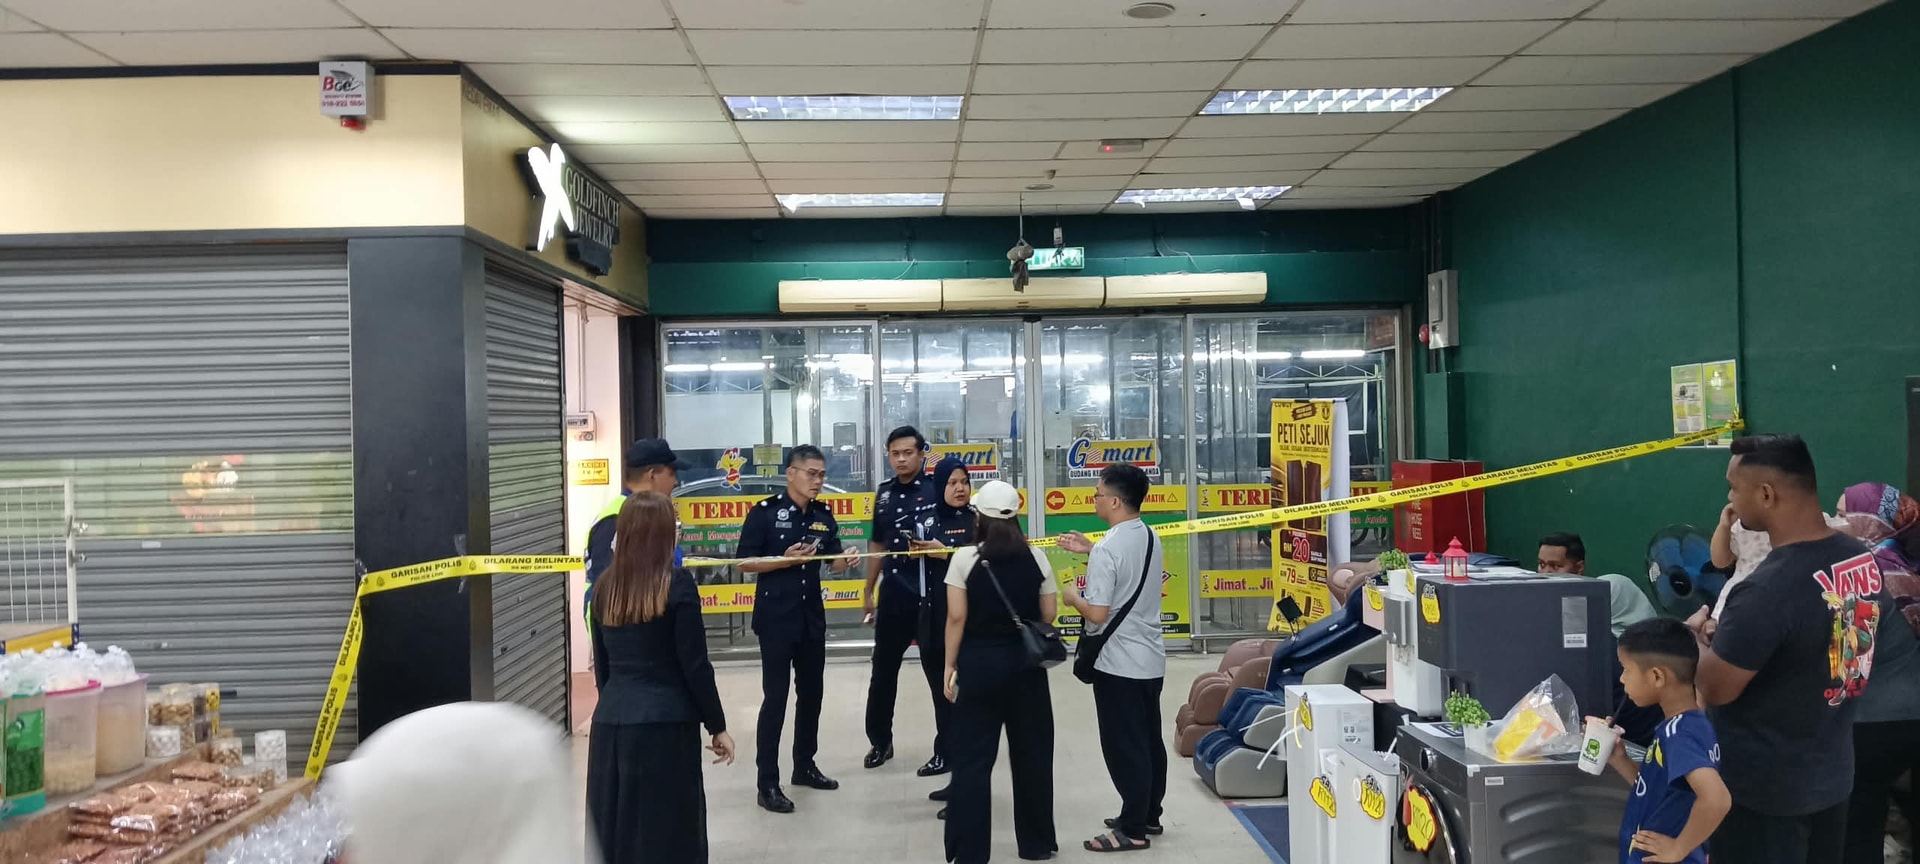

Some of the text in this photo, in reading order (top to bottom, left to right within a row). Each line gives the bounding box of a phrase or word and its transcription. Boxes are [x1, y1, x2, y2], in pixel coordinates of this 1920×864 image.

[565, 167, 620, 227] GOLDFINCH
[574, 205, 614, 249] JEWELRY
[1278, 423, 1330, 446] PETI SEJUK
[1069, 439, 1153, 468] G mart
[1576, 445, 1639, 461] GARISAN POLIS
[1472, 461, 1558, 482] DILARANG MELINTAS
[1390, 481, 1454, 497] GARISAN POLIS
[1283, 496, 1371, 514] DILARANG MELINTAS
[1200, 512, 1265, 525] GARISAN POLIS
[1412, 527, 1423, 540] REEL
[1292, 537, 1310, 563] 20
[391, 559, 462, 579] GARISAN POLIS
[1287, 568, 1296, 583] 79
[1813, 552, 1882, 600] VANS
[834, 589, 859, 599] mart
[1214, 578, 1247, 590] Jimat
[339, 620, 358, 666] DILARANG
[312, 686, 338, 759] GARISAN POLIS
